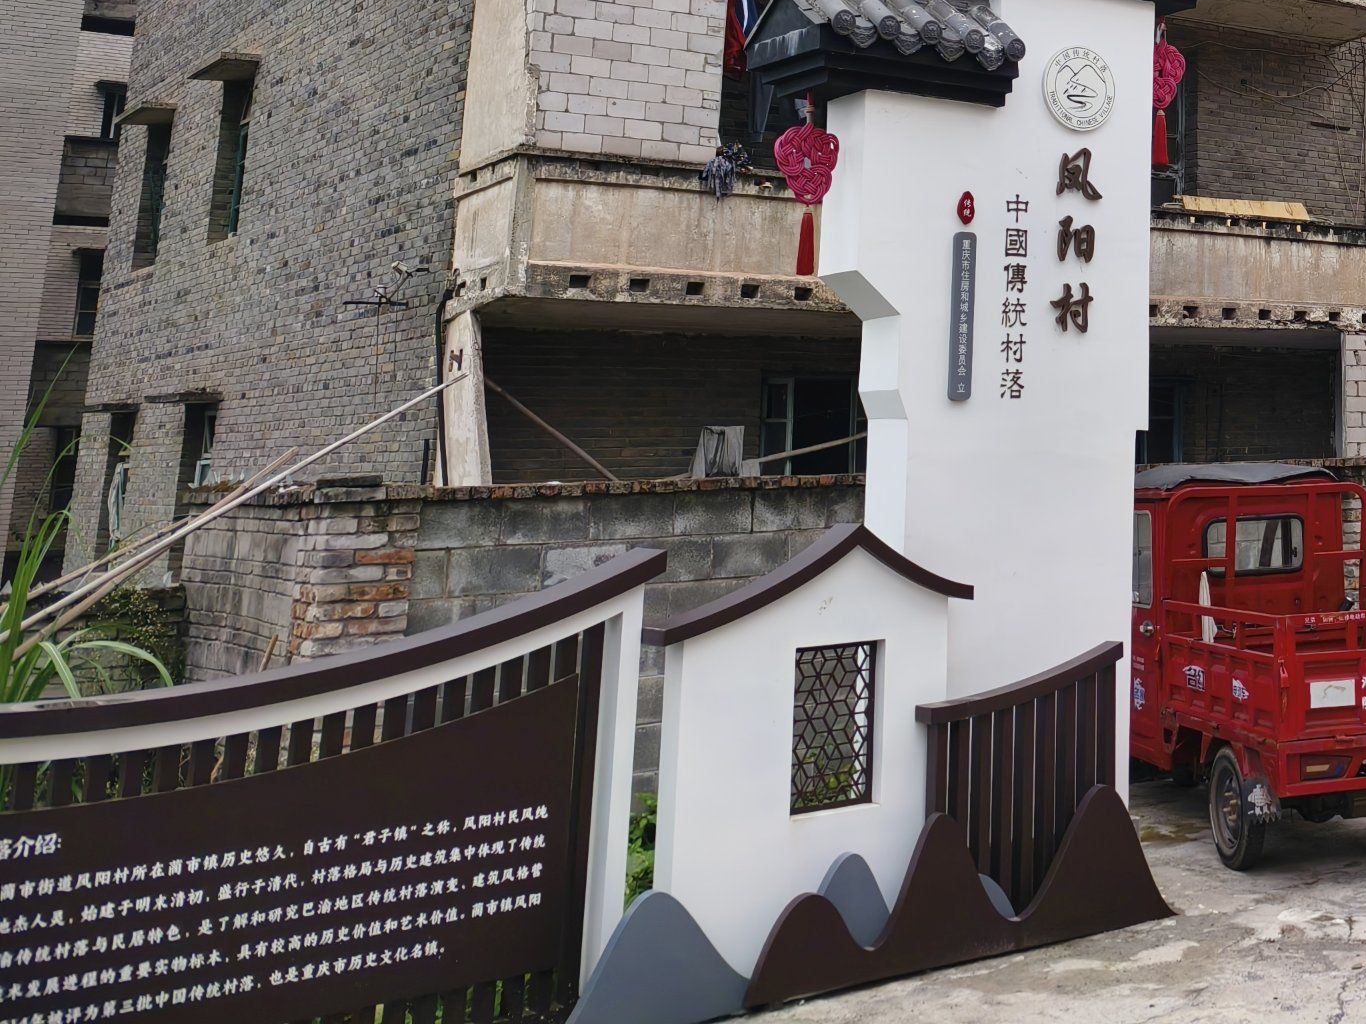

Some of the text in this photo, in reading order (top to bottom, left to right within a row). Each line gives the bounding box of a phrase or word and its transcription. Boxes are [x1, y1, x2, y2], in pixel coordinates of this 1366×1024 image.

[1049, 90, 1113, 127] TRADITIONAL CHINESE VILLAGE
[956, 239, 971, 393] 重庆市住房和城乡建设委员会 立
[1000, 193, 1029, 399] 中國傳統村落
[1050, 147, 1102, 333] 凤阳村
